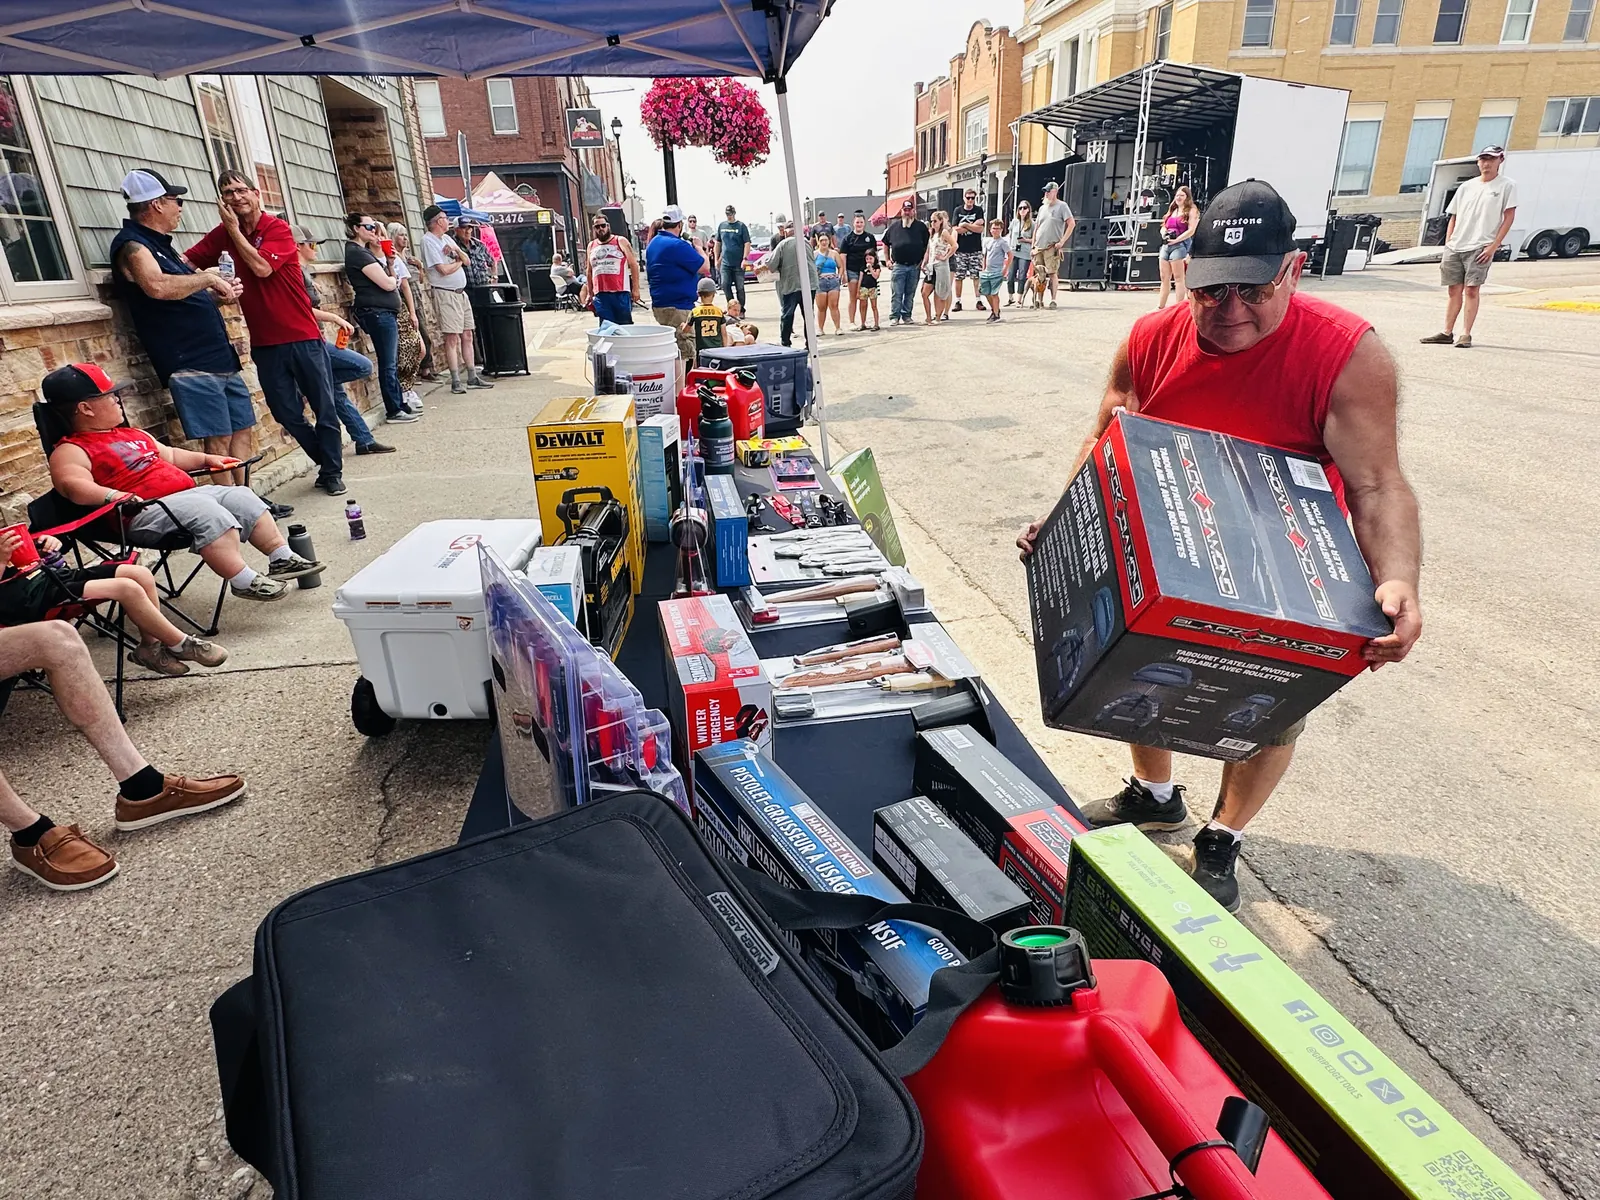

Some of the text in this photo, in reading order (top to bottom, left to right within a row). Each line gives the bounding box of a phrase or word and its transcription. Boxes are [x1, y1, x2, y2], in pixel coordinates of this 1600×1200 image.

[1212, 217, 1262, 229] Firestone
[1226, 231, 1241, 239] AG
[701, 320, 718, 336] 23
[638, 382, 663, 393] Value
[535, 432, 604, 447] DEWALT
[1076, 474, 1092, 524] PIVOTANT
[1176, 434, 1234, 595] BLACK DIAMOND
[1069, 486, 1092, 573] AVEC ROULETTES
[1082, 463, 1109, 574] TABOURET D'ATELIER
[1174, 618, 1344, 658] BLACK DIAMOND
[1176, 649, 1303, 680] TABOURET D'ATELIER PIVOTANT
[1176, 656, 1290, 683] RÉGLABLE AVEC ROULETTES
[696, 708, 708, 744] WINTER
[709, 699, 722, 746] MERGENCY
[723, 715, 736, 731] KIT
[729, 766, 817, 855] PISTOLET-GRAISSEUR
[915, 800, 952, 829] COAST
[806, 815, 867, 876] HARVEST KING
[710, 894, 770, 970] UNDER ARMOUR
[926, 937, 953, 961] 6000
[1305, 1046, 1364, 1100] @GRIPEDGETOOLS
